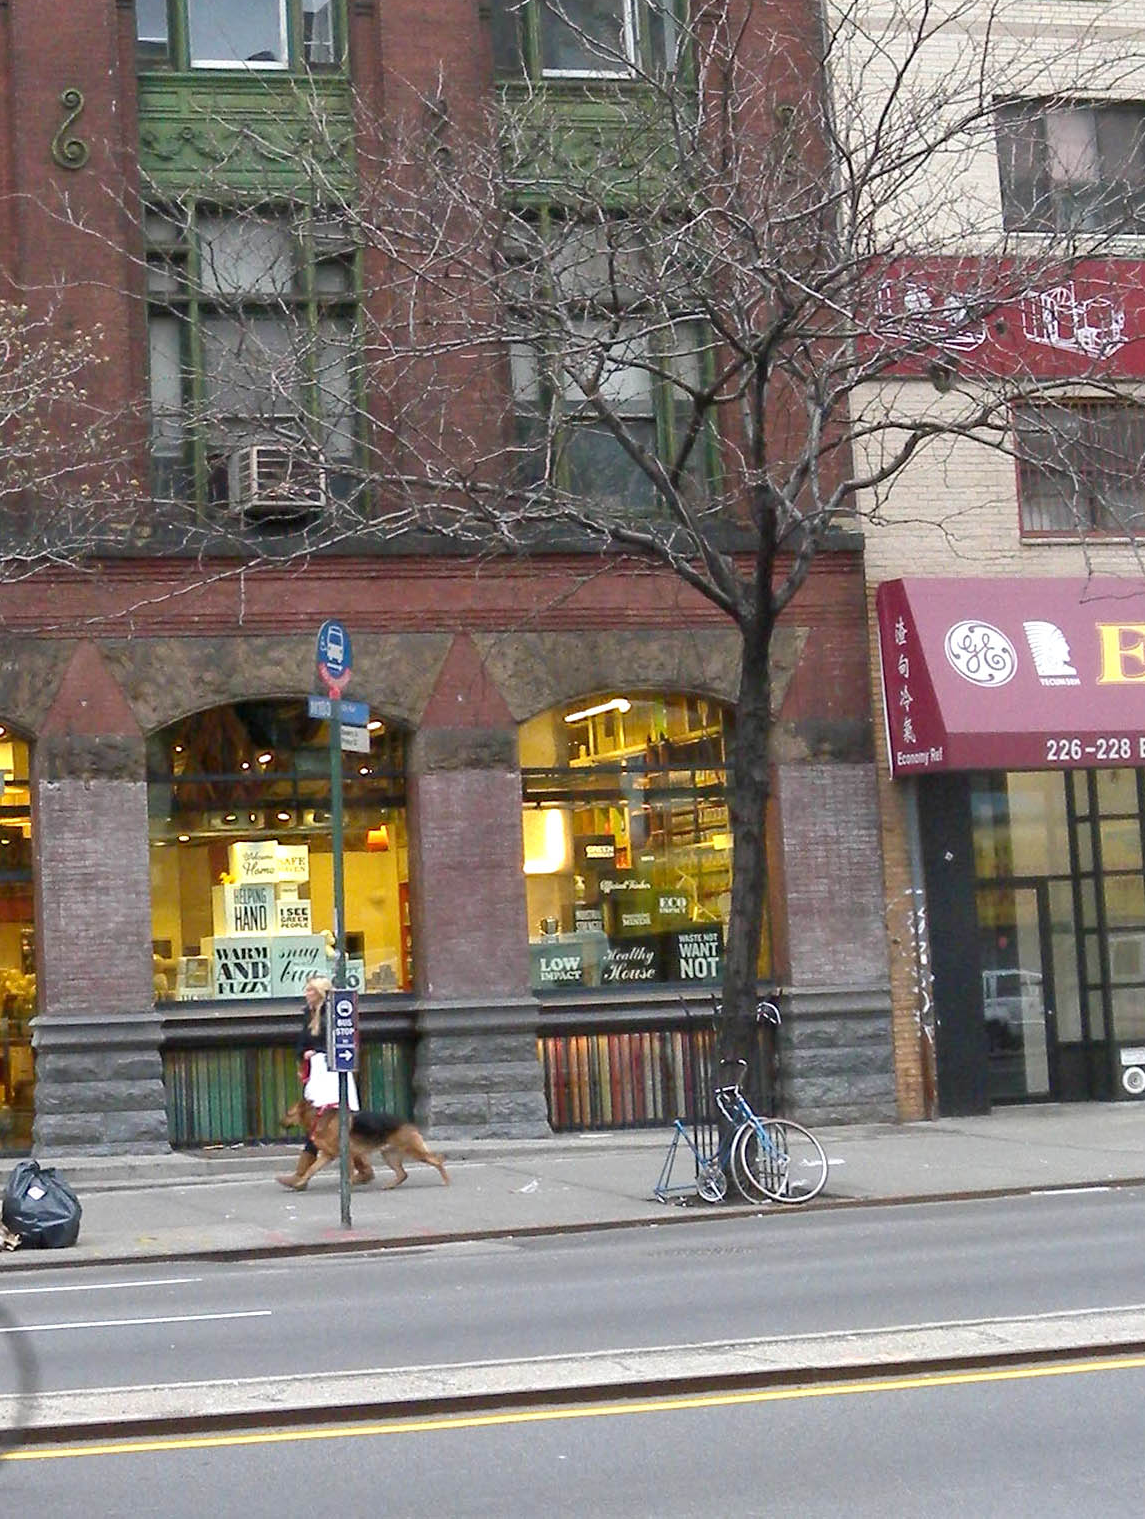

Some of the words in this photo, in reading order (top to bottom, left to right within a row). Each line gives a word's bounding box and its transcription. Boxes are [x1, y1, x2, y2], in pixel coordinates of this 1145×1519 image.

[1046, 738, 1131, 760] 226-228
[897, 752, 929, 766] Economy
[234, 889, 267, 904] HELPING
[659, 897, 687, 907] ECO
[235, 905, 267, 931] HAND
[287, 908, 308, 916] SEE
[679, 934, 702, 943] WASTE
[703, 933, 717, 941] NOT
[216, 947, 268, 961] WARM
[279, 947, 320, 964] snug
[603, 946, 655, 964] Healthy
[679, 943, 718, 957] WANT
[216, 962, 271, 980] AND
[540, 957, 581, 971] LOW
[680, 957, 719, 979] NOT
[541, 971, 582, 980] IMPACT
[603, 963, 656, 980] House
[218, 981, 269, 994] FUZZY
[337, 1018, 353, 1027] BUS
[335, 1027, 355, 1035] STOP
